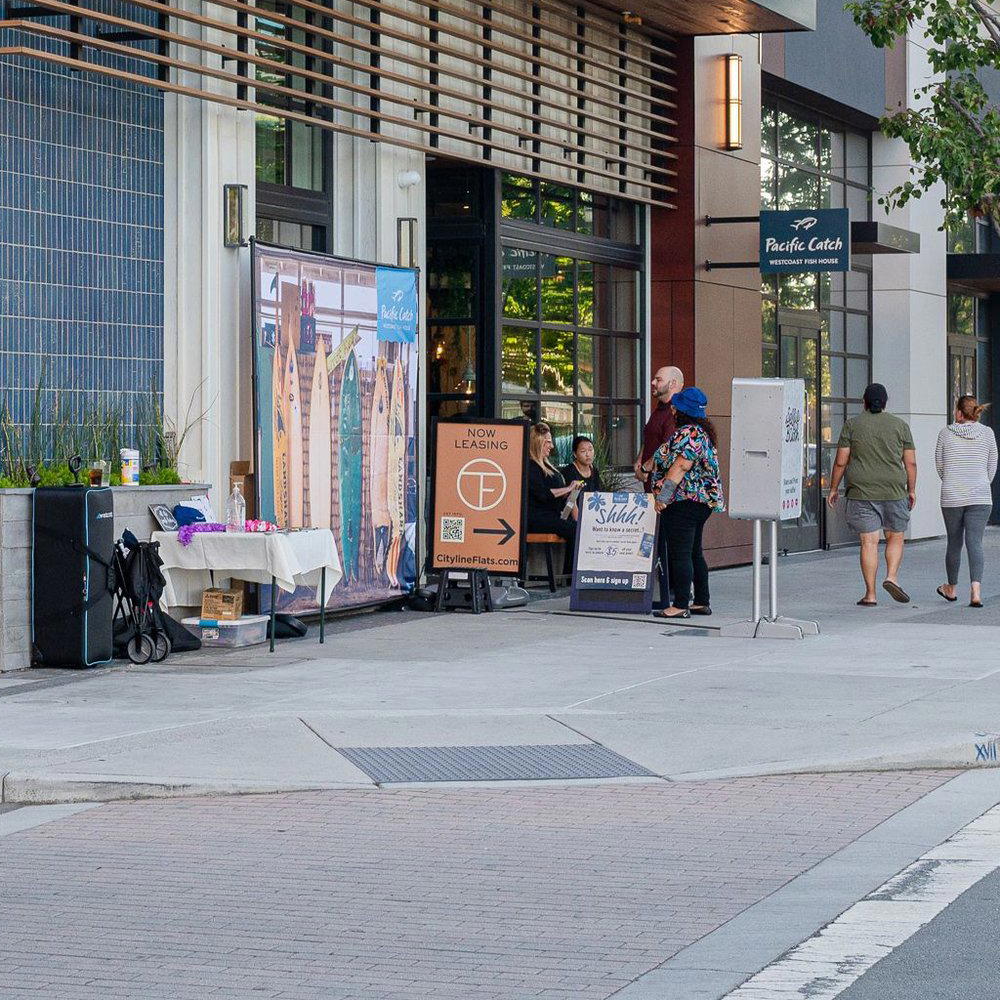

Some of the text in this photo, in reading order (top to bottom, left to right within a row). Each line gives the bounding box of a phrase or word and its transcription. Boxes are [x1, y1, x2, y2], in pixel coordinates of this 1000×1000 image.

[766, 237, 842, 253] Pacific Catch
[467, 428, 496, 438] NOW
[454, 440, 508, 450] LEASING
[436, 554, 518, 566] CitylineFlats.com
[610, 577, 621, 585] sign
